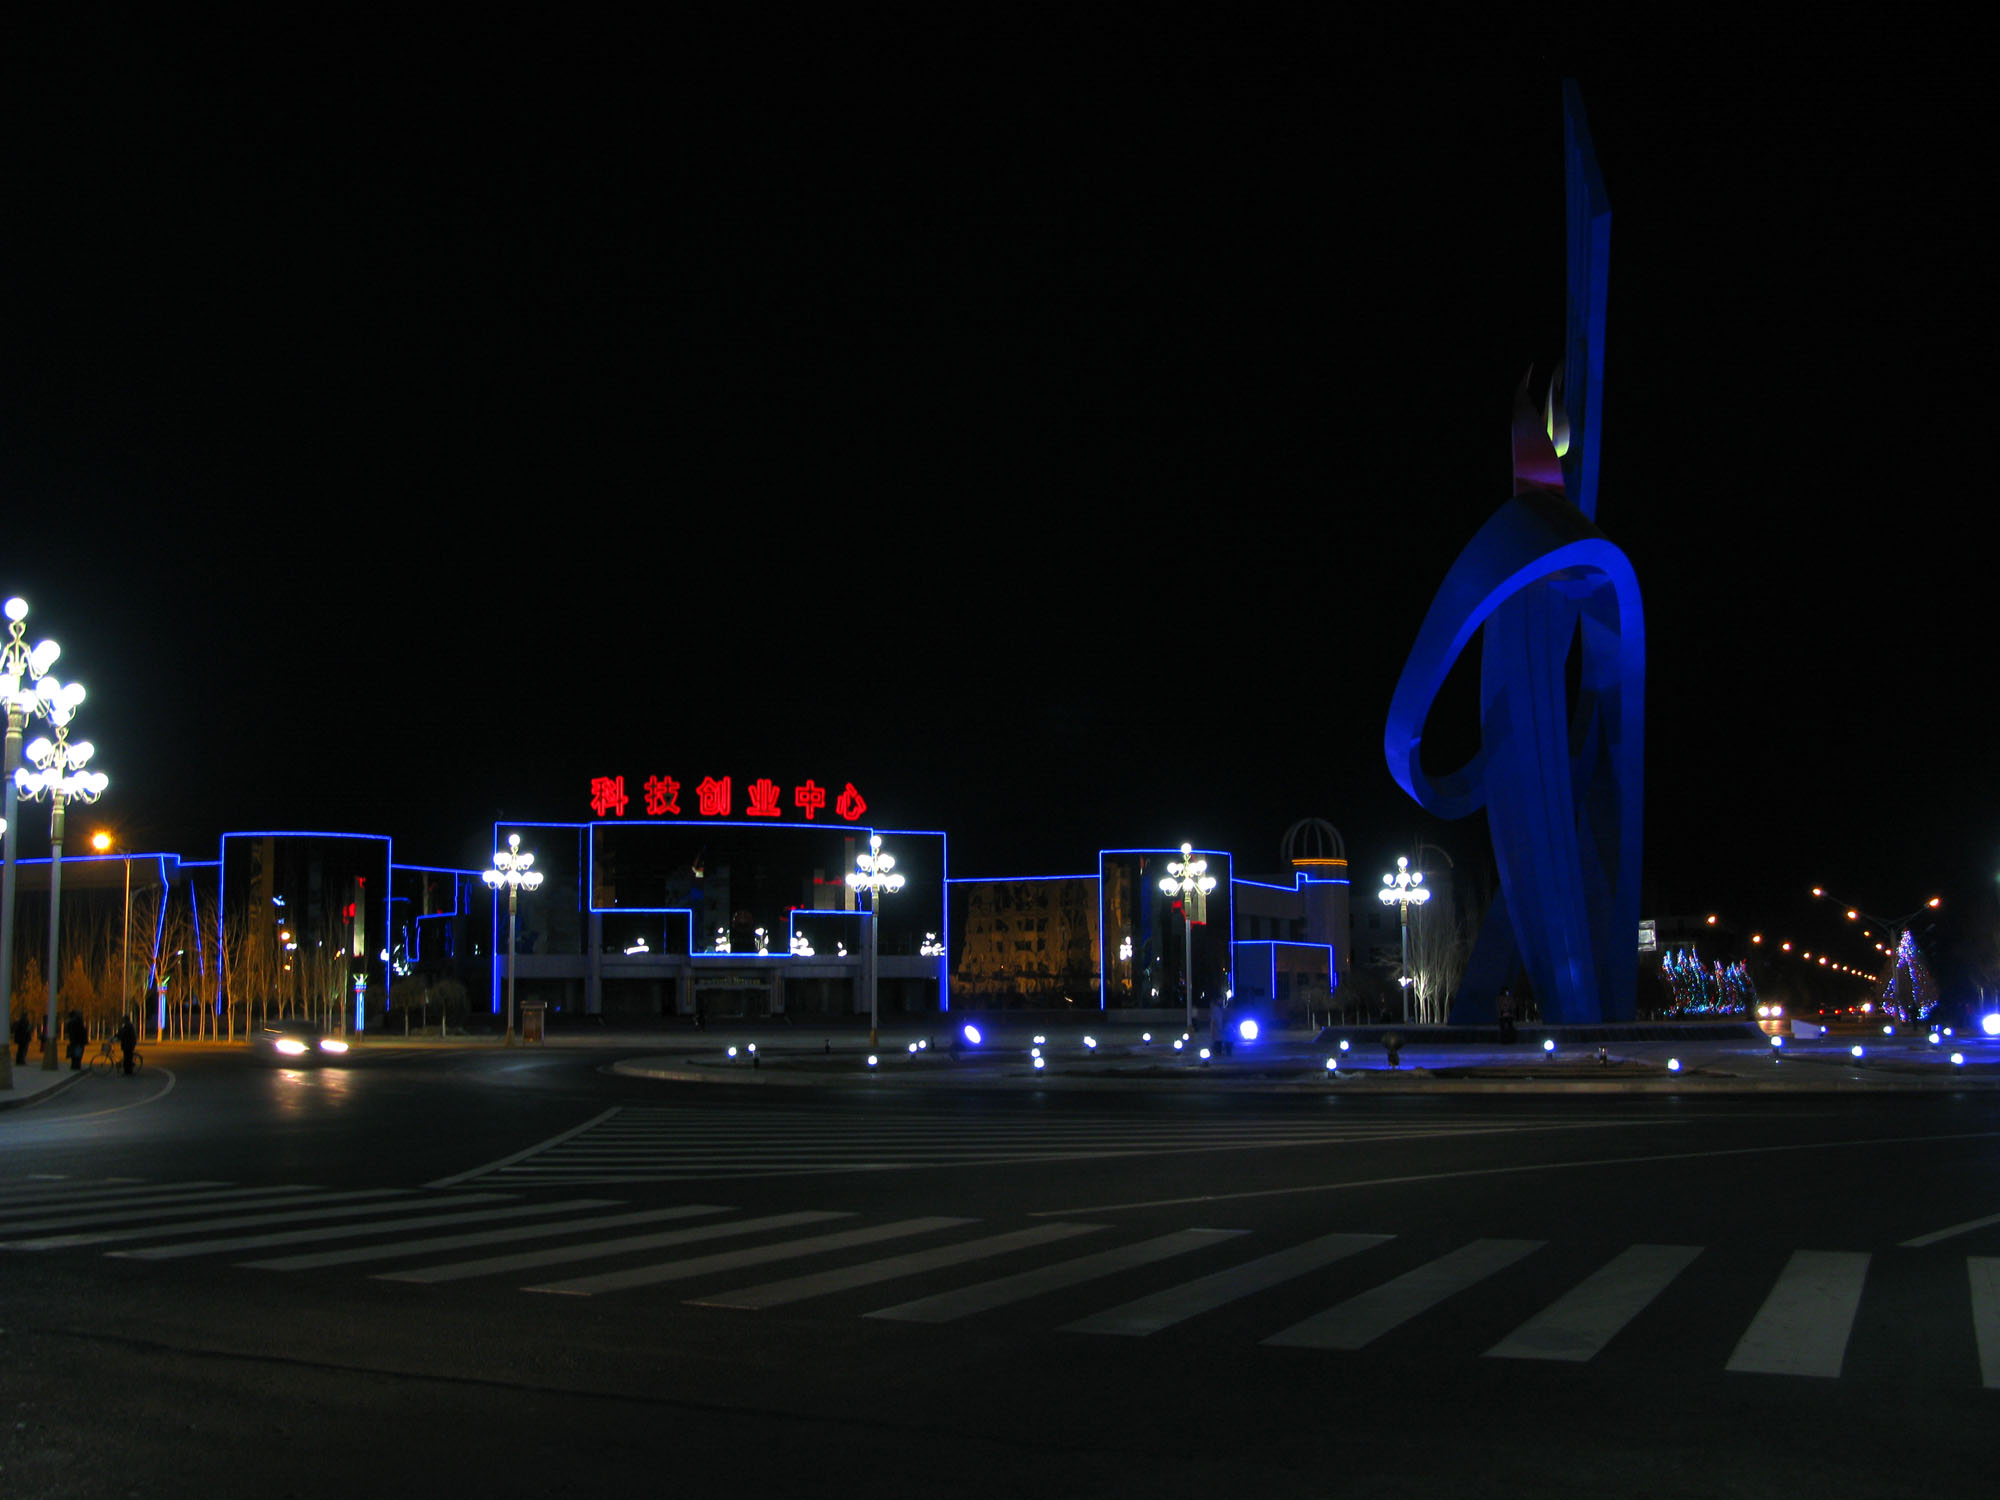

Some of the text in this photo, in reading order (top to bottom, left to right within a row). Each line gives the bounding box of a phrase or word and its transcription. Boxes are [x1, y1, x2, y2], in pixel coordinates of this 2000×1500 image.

[591, 775, 867, 821] 科技创业中心
